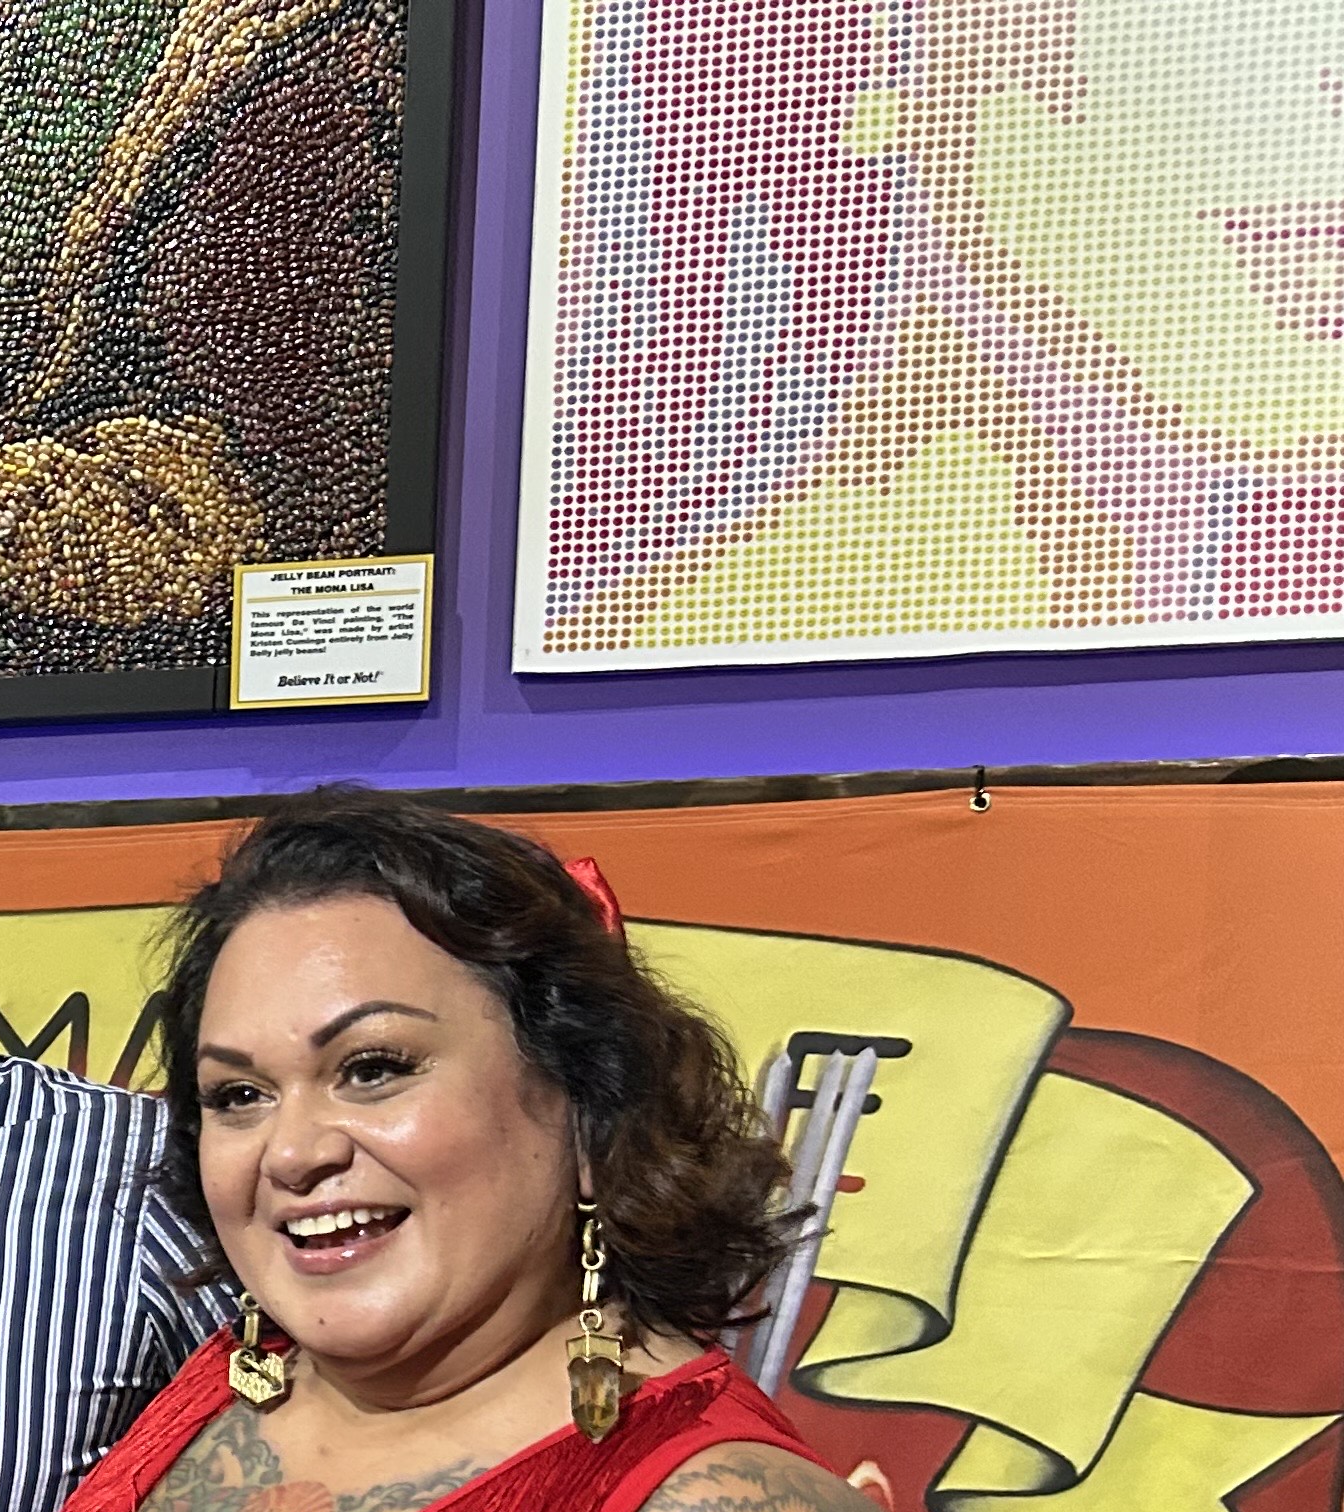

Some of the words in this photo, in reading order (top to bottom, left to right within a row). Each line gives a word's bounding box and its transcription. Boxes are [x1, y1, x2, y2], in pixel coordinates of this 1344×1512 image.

[271, 572, 303, 581] JELLY
[306, 570, 335, 580] BEAN
[338, 567, 396, 577] PORTRAIT:
[291, 586, 312, 595] THE
[315, 584, 346, 593] MONA
[350, 583, 374, 591] LISA
[371, 624, 382, 632] by
[277, 674, 321, 687] Believe
[323, 673, 335, 685] It
[337, 675, 351, 684] or
[352, 671, 380, 684] Not!
